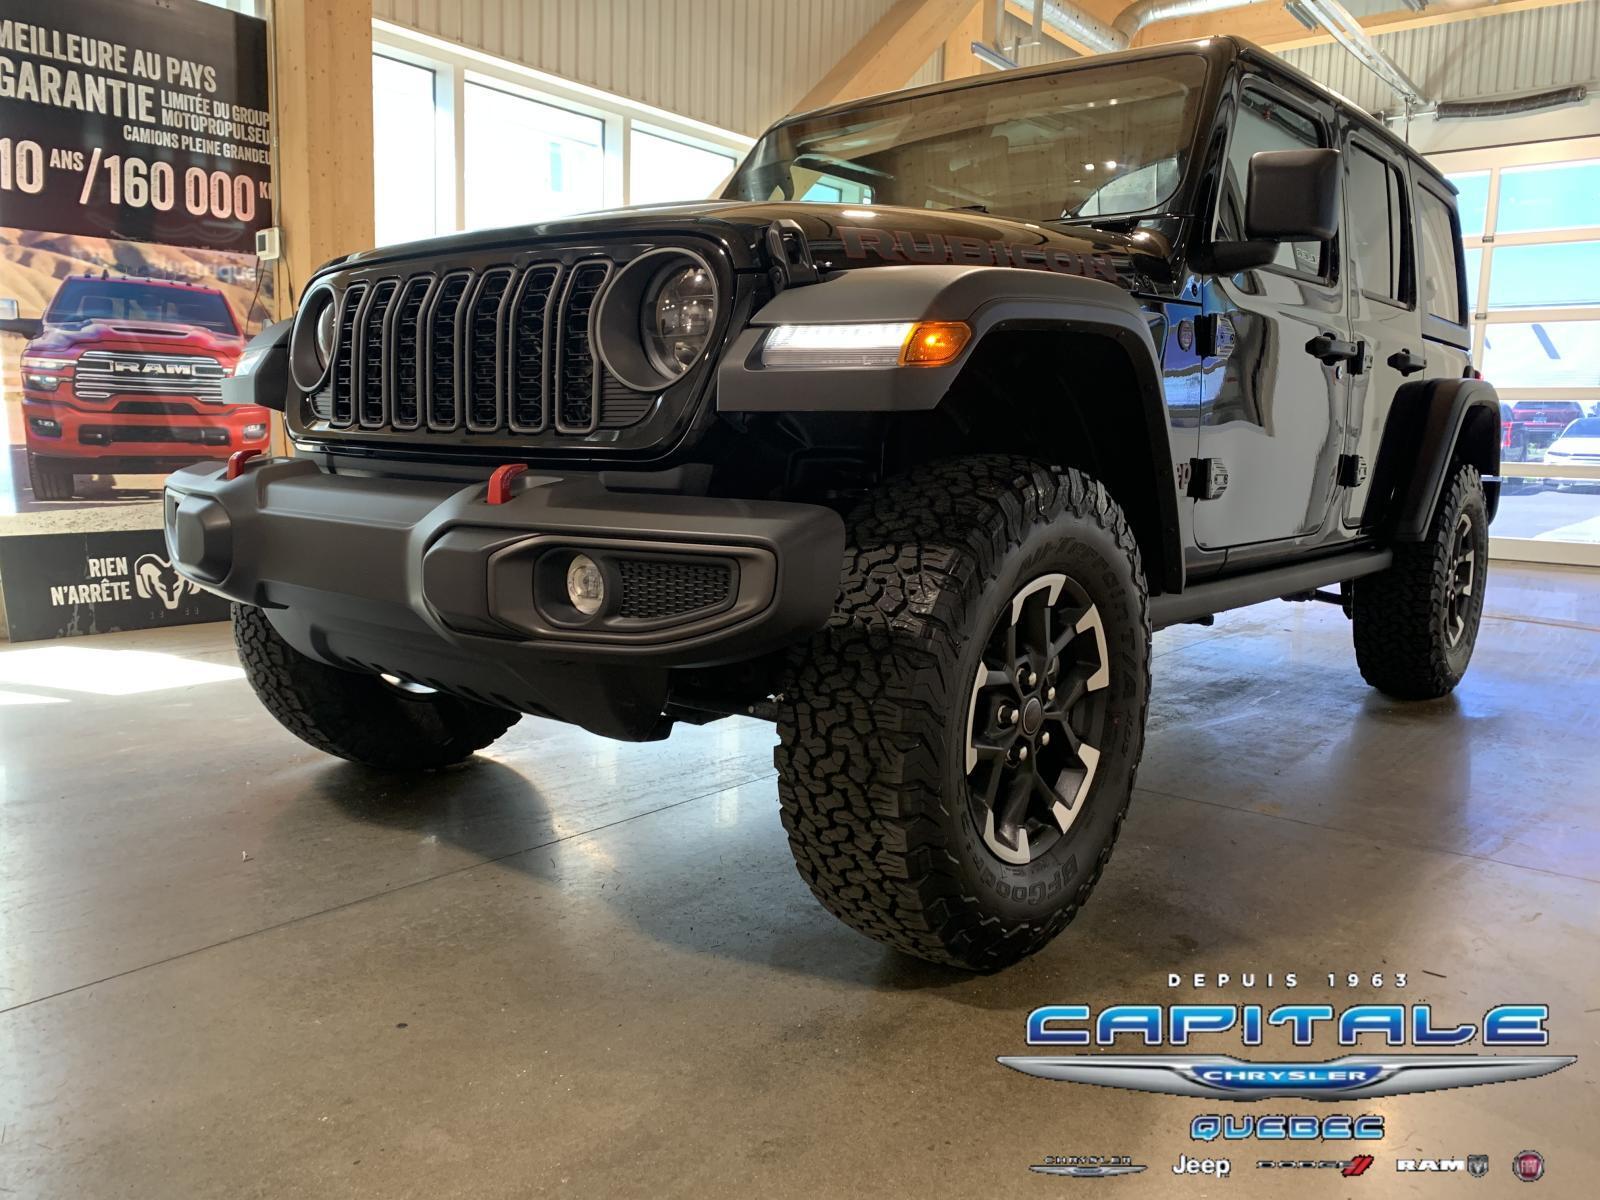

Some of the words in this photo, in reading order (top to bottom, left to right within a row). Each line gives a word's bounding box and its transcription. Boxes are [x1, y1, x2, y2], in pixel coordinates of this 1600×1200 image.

[0, 19, 128, 74] MEILLEURE
[132, 49, 162, 81] AU
[166, 56, 217, 93] PAYS
[0, 55, 156, 124] GARANTIE
[161, 89, 211, 116] LIMITÉE
[213, 100, 230, 120] DU
[123, 124, 179, 149] CAMIONS
[181, 135, 222, 156] PLEINE
[0, 137, 44, 194] 10
[49, 148, 84, 172] ANS
[836, 225, 1118, 282] RUBICON
[115, 361, 191, 375] RAM
[88, 556, 128, 578] RIEN
[50, 578, 132, 607] N'ARRÊTE
